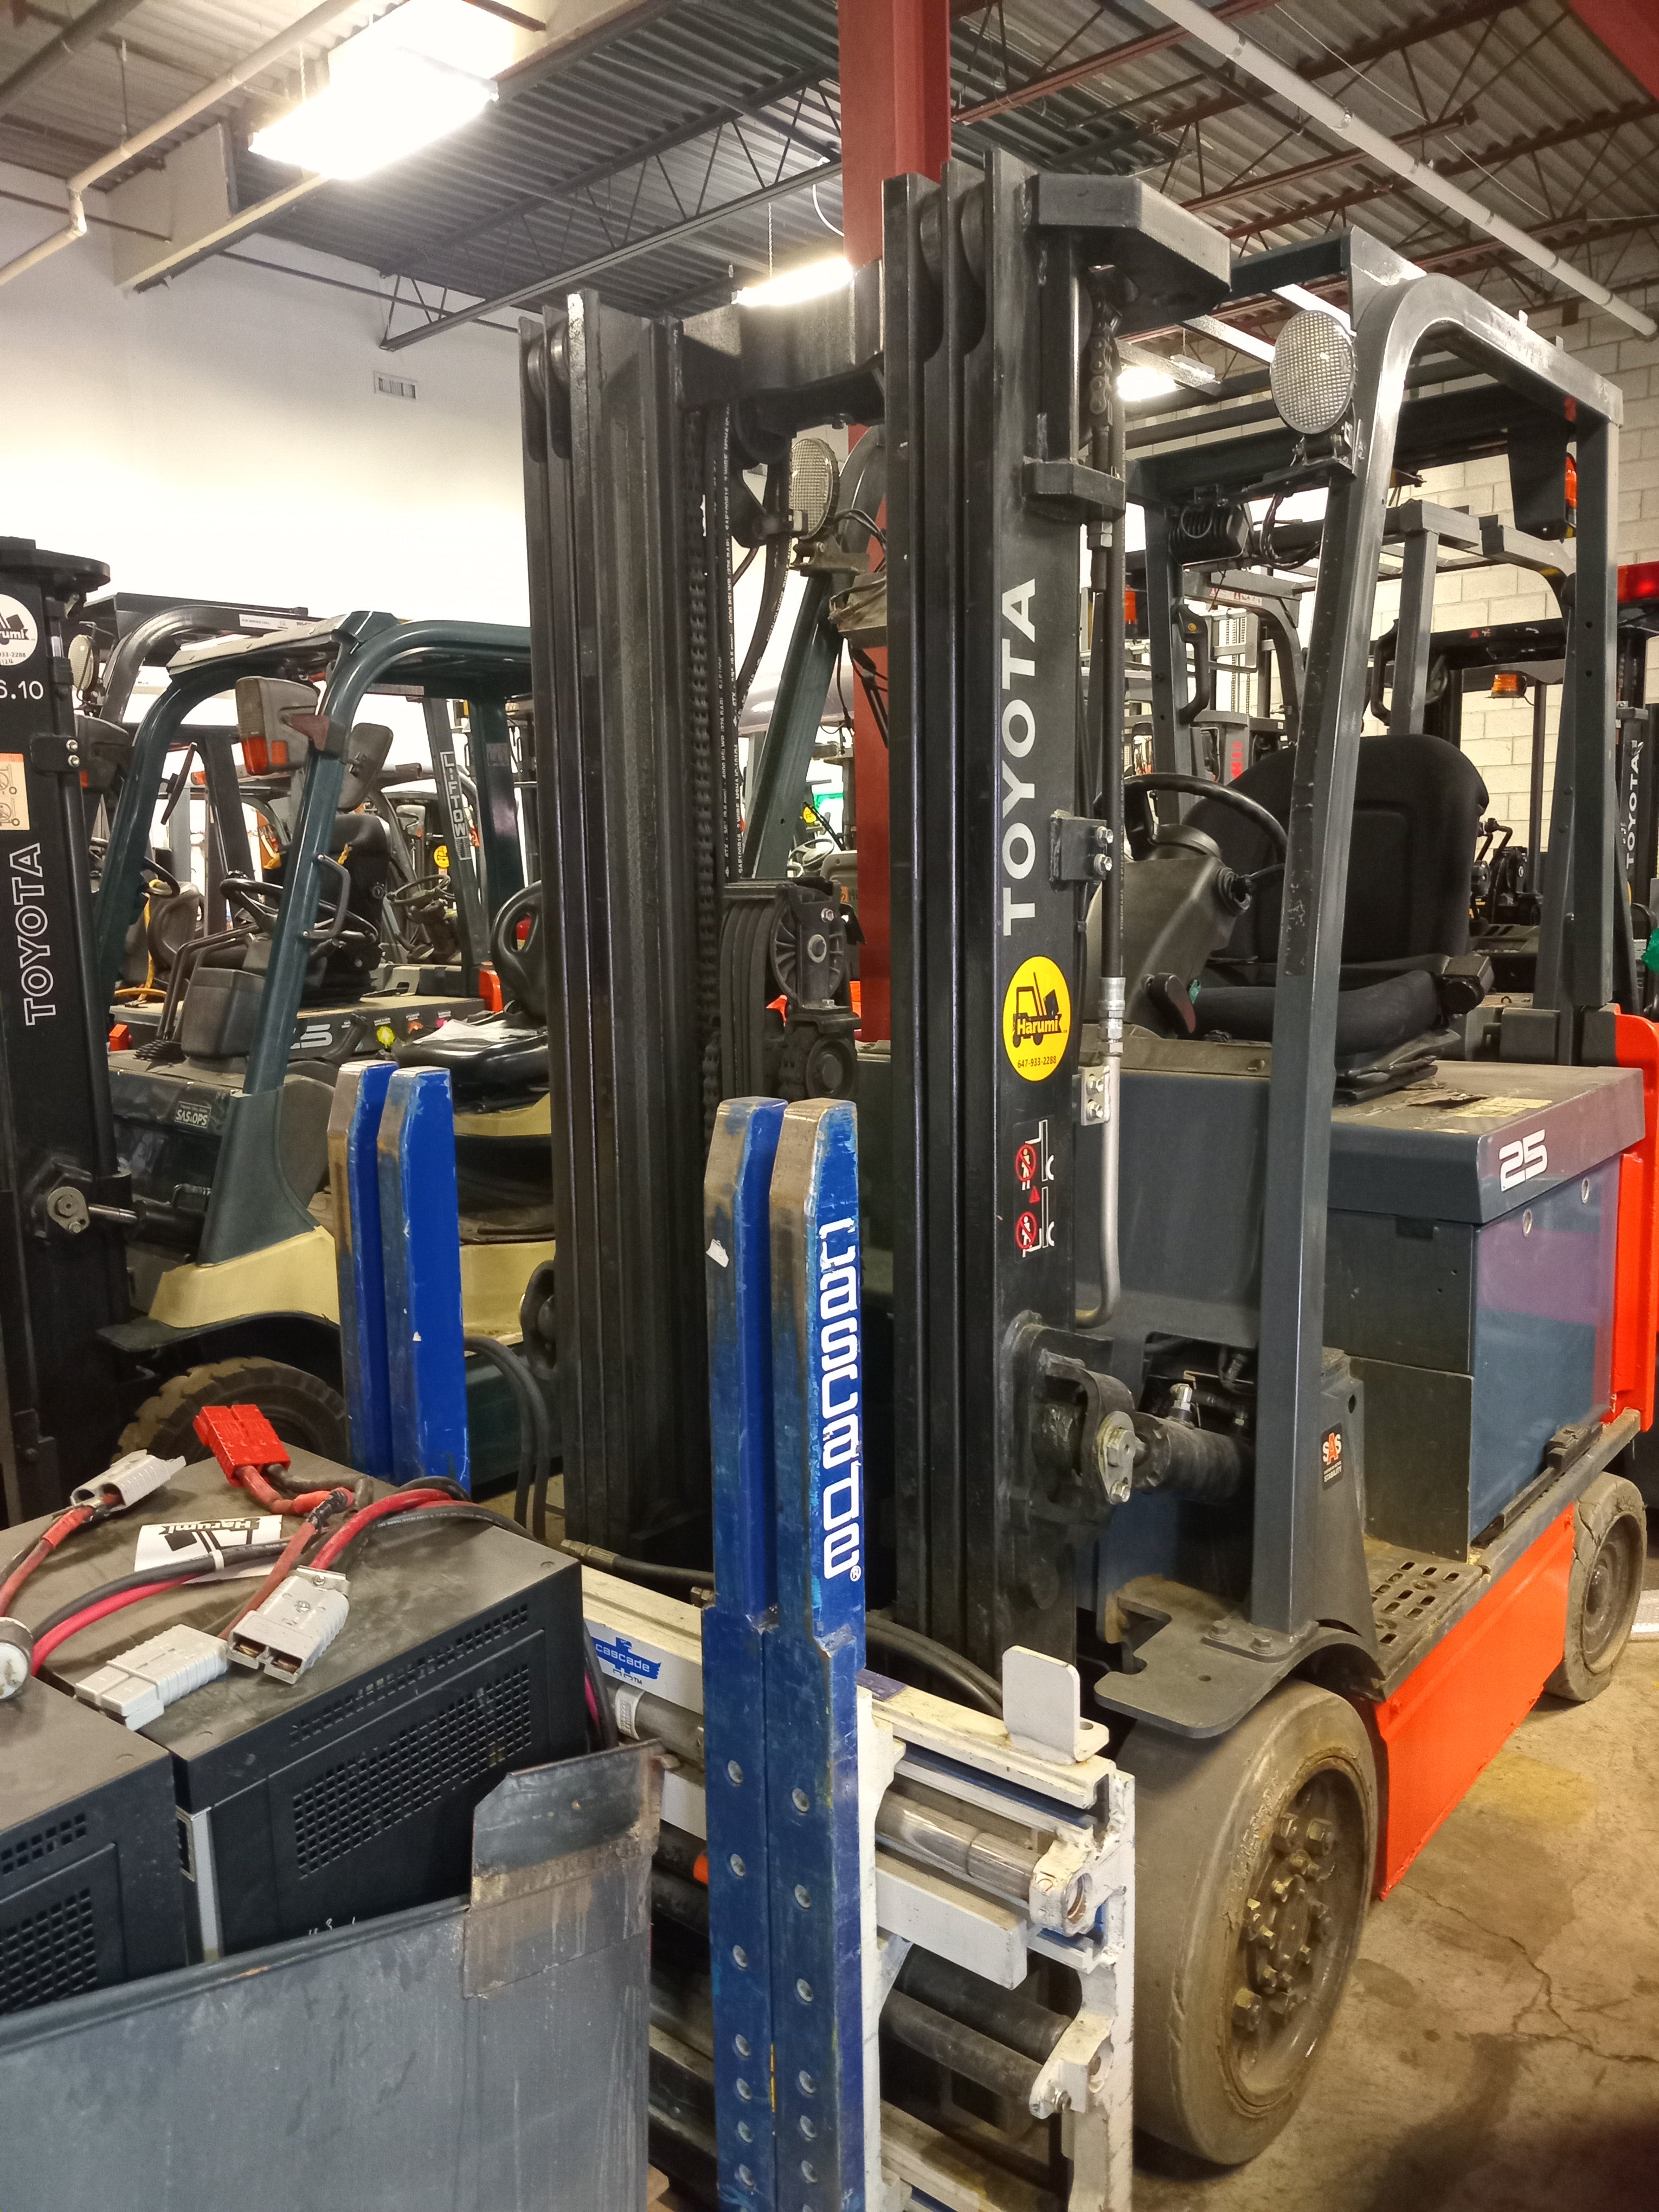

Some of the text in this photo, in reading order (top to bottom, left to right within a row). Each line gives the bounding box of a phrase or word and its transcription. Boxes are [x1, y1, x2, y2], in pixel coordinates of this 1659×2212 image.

[1002, 578, 1036, 936] TOYOTA
[443, 754, 467, 837] LIFTOW
[1626, 753, 1639, 870] TOYOTA
[9, 843, 56, 1026] TOYOTA
[1017, 1015, 1058, 1036] Harumi
[1017, 1056, 1057, 1068] 647-933-2288
[1499, 1129, 1548, 1192] 25
[1323, 1432, 1342, 1465] SAS
[168, 1520, 252, 1534] Harumi
[596, 1644, 650, 1673] cascade
